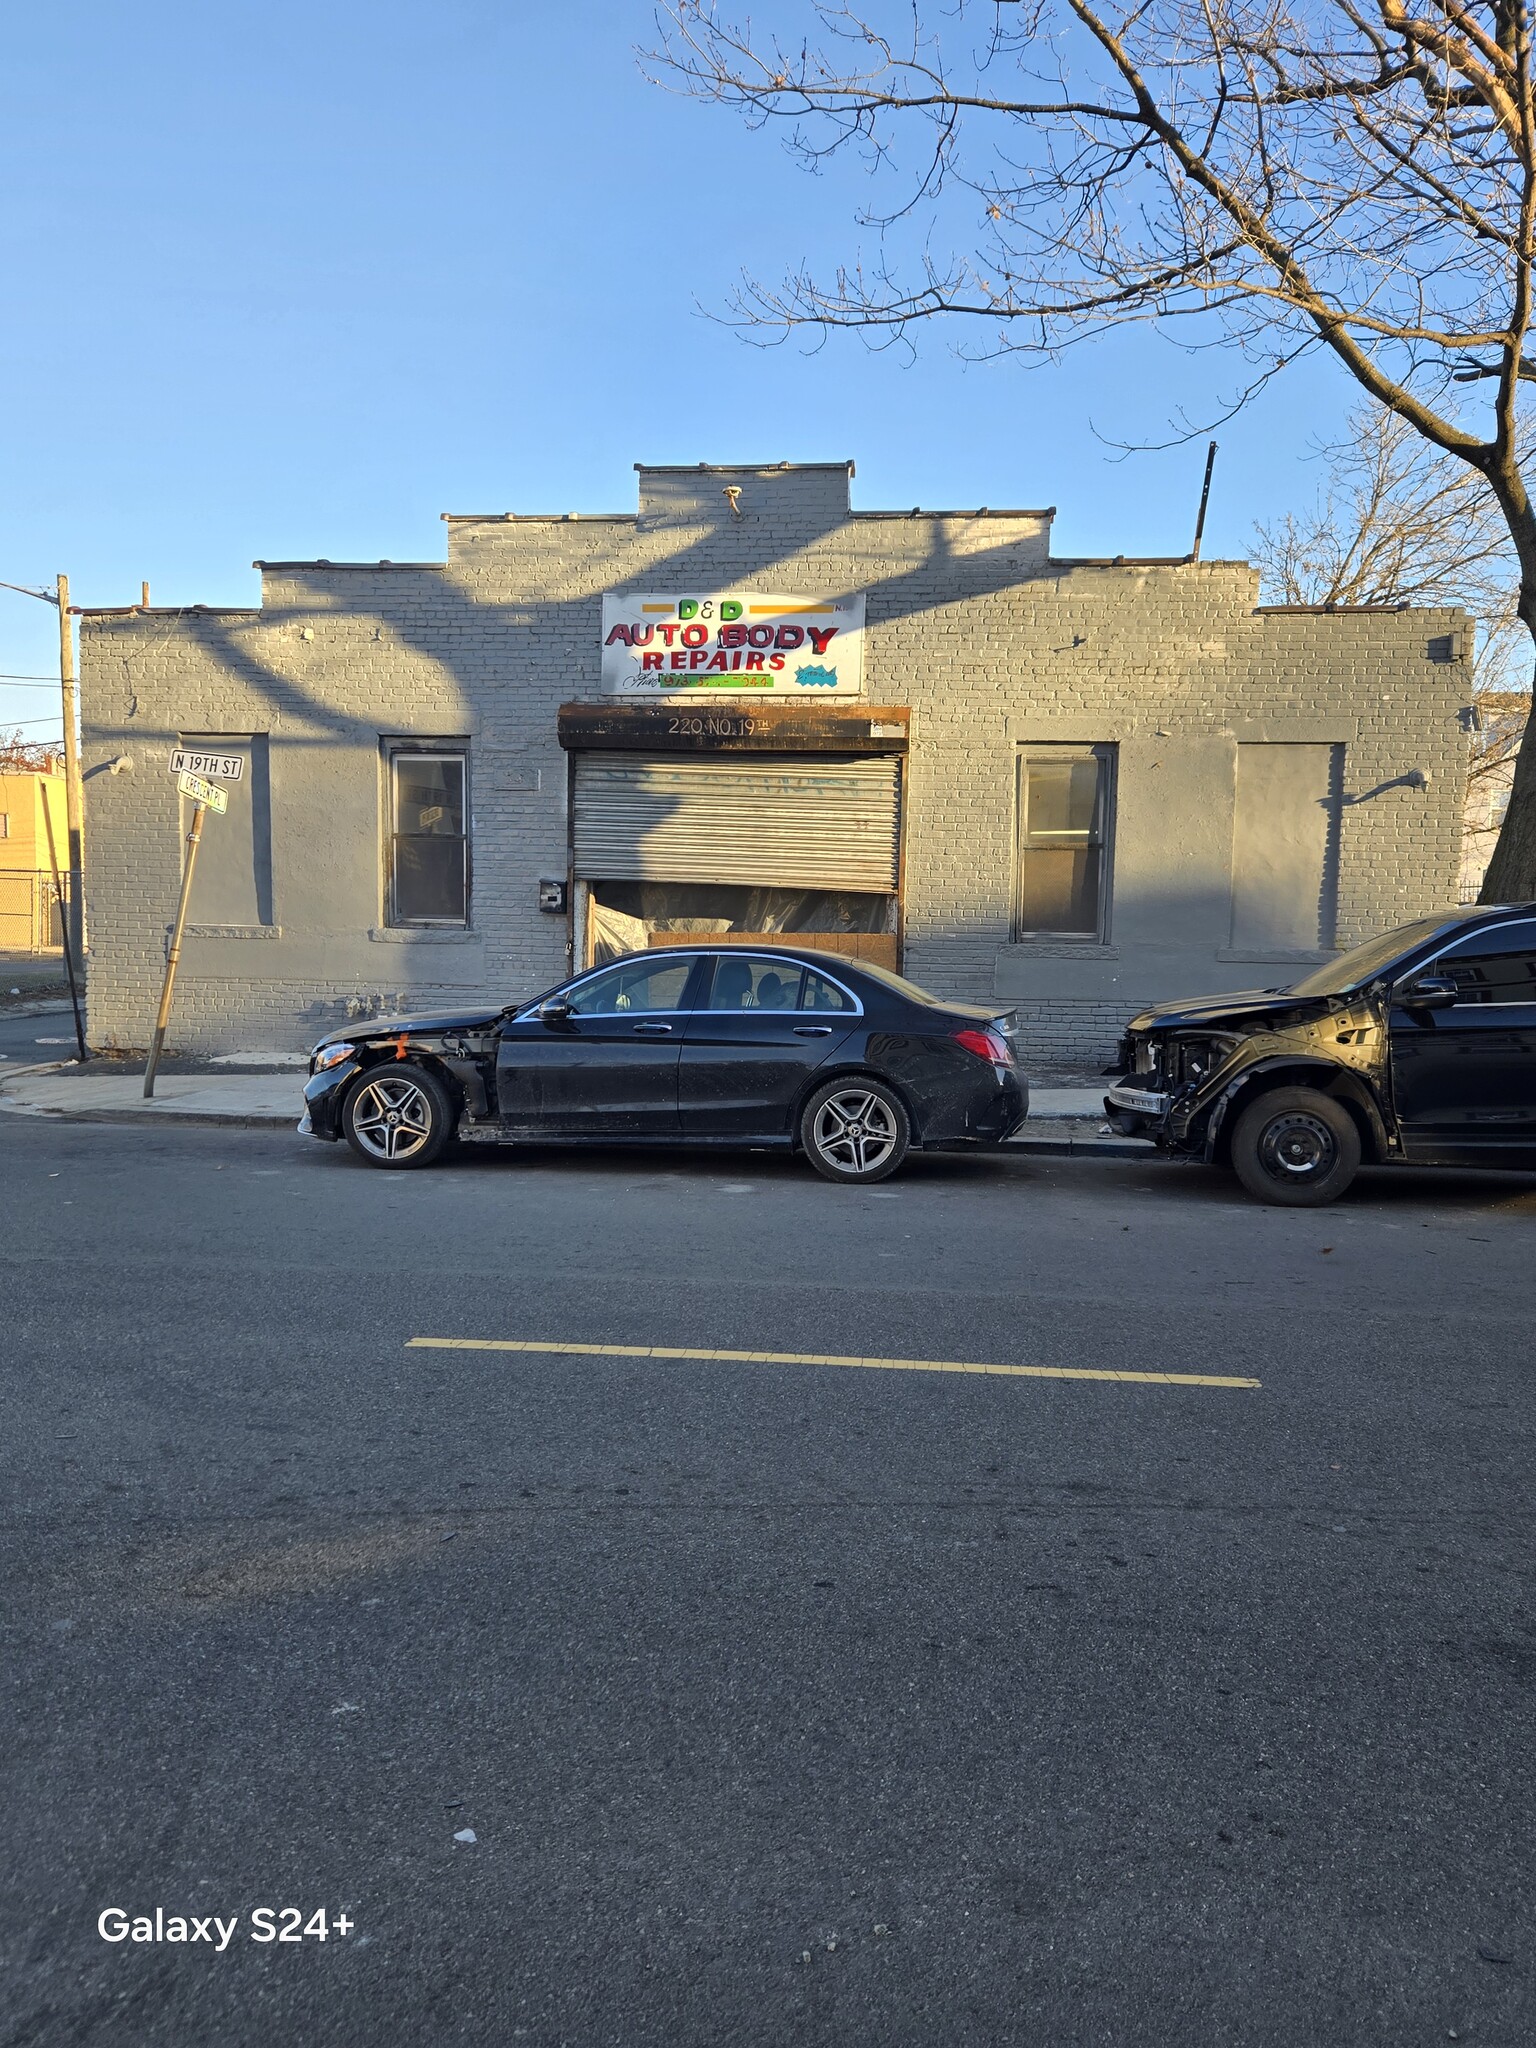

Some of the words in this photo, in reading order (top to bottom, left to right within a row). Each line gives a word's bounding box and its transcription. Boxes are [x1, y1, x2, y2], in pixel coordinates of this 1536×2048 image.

[679, 599, 699, 620] D
[701, 601, 714, 619] &
[720, 601, 743, 621] D
[604, 623, 709, 649] AUTO
[717, 624, 840, 655] BODY
[642, 650, 786, 672] REPAIRS
[668, 717, 703, 734] 220
[739, 718, 771, 735] 19TH
[176, 754, 184, 769] N
[189, 756, 219, 773] 19TH
[222, 760, 238, 775] ST
[186, 776, 214, 802] CRESCENT
